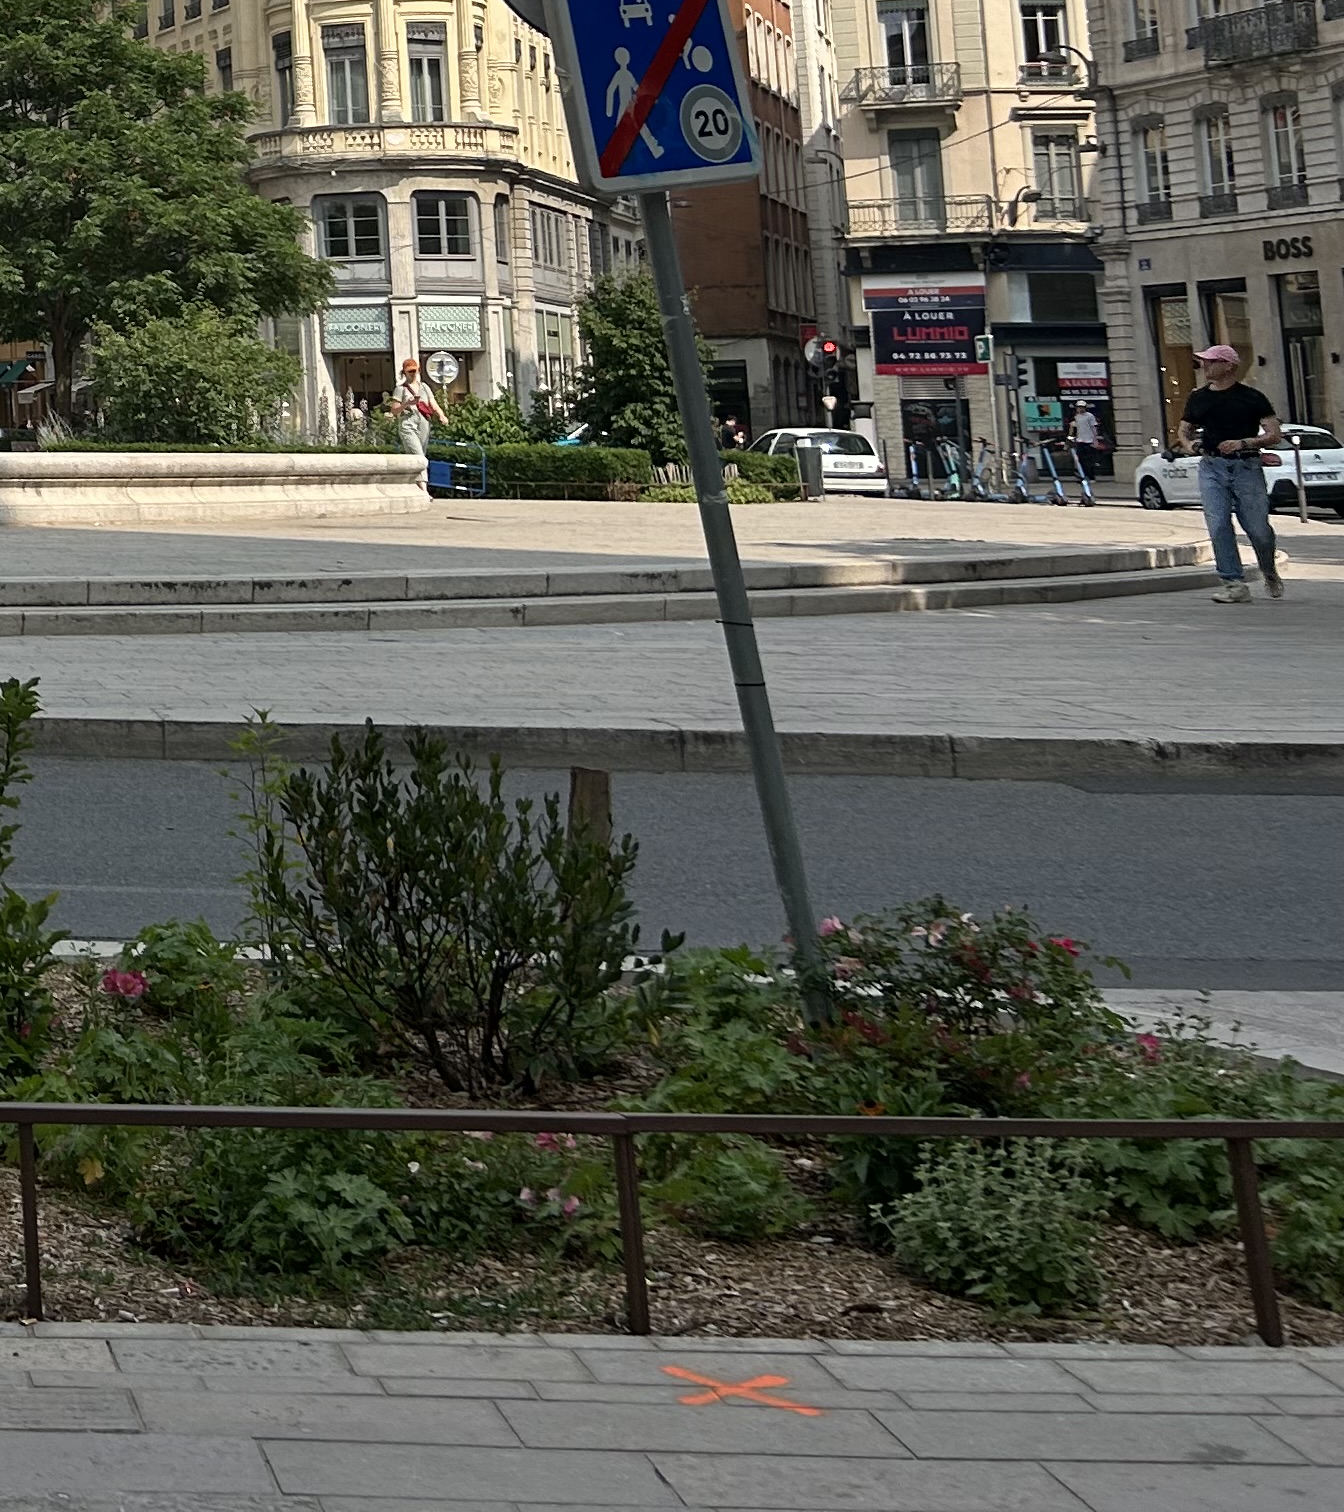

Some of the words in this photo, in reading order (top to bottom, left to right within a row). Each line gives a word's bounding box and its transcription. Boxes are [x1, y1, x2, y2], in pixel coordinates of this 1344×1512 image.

[694, 108, 730, 138] 20
[1263, 236, 1314, 261] BOSS
[914, 312, 955, 320] LOUER
[328, 323, 382, 333] FALCONERI
[424, 323, 475, 333] FALCONERI
